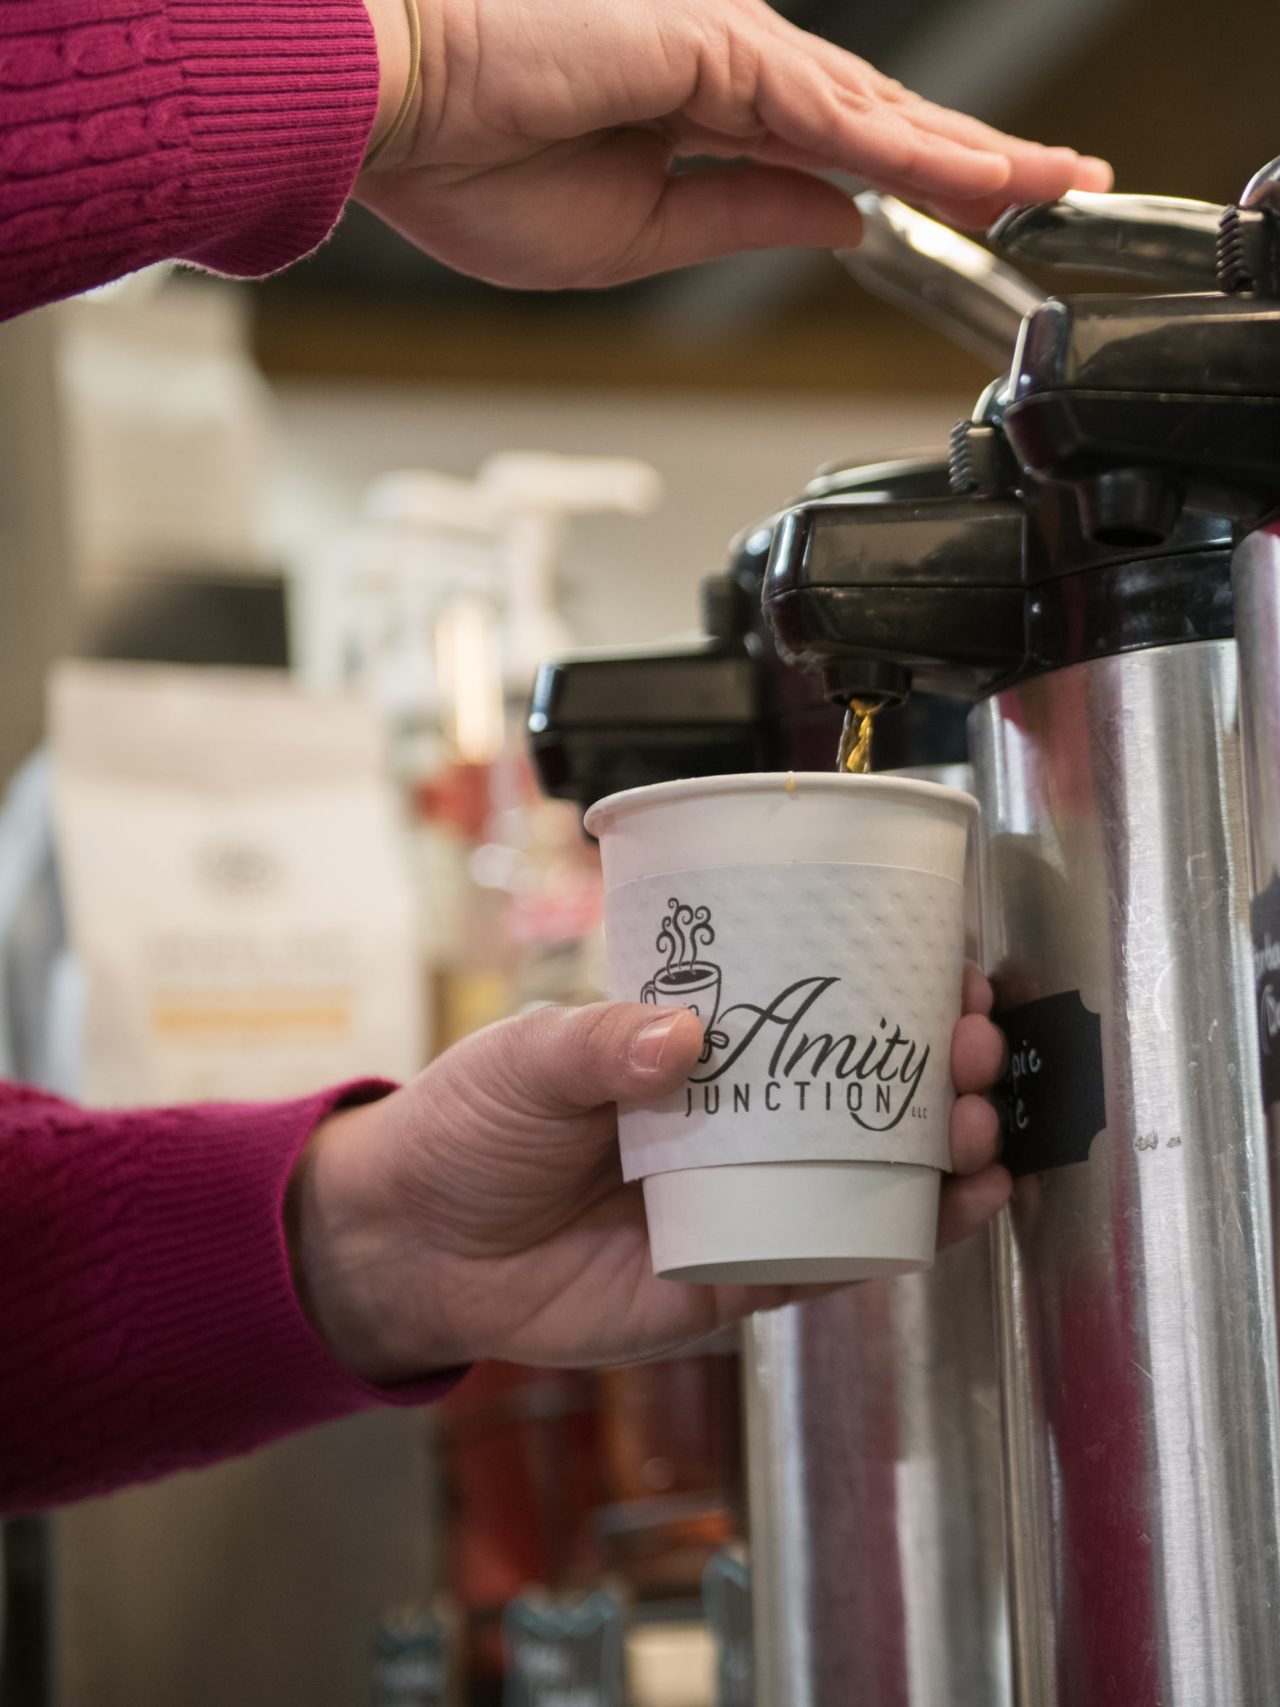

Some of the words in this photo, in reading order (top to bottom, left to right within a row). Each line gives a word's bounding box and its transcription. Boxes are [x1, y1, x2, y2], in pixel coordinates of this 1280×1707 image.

[688, 976, 930, 1131] Amity
[684, 1081, 891, 1118] JUNCTION
[911, 1106, 927, 1119] LLC
